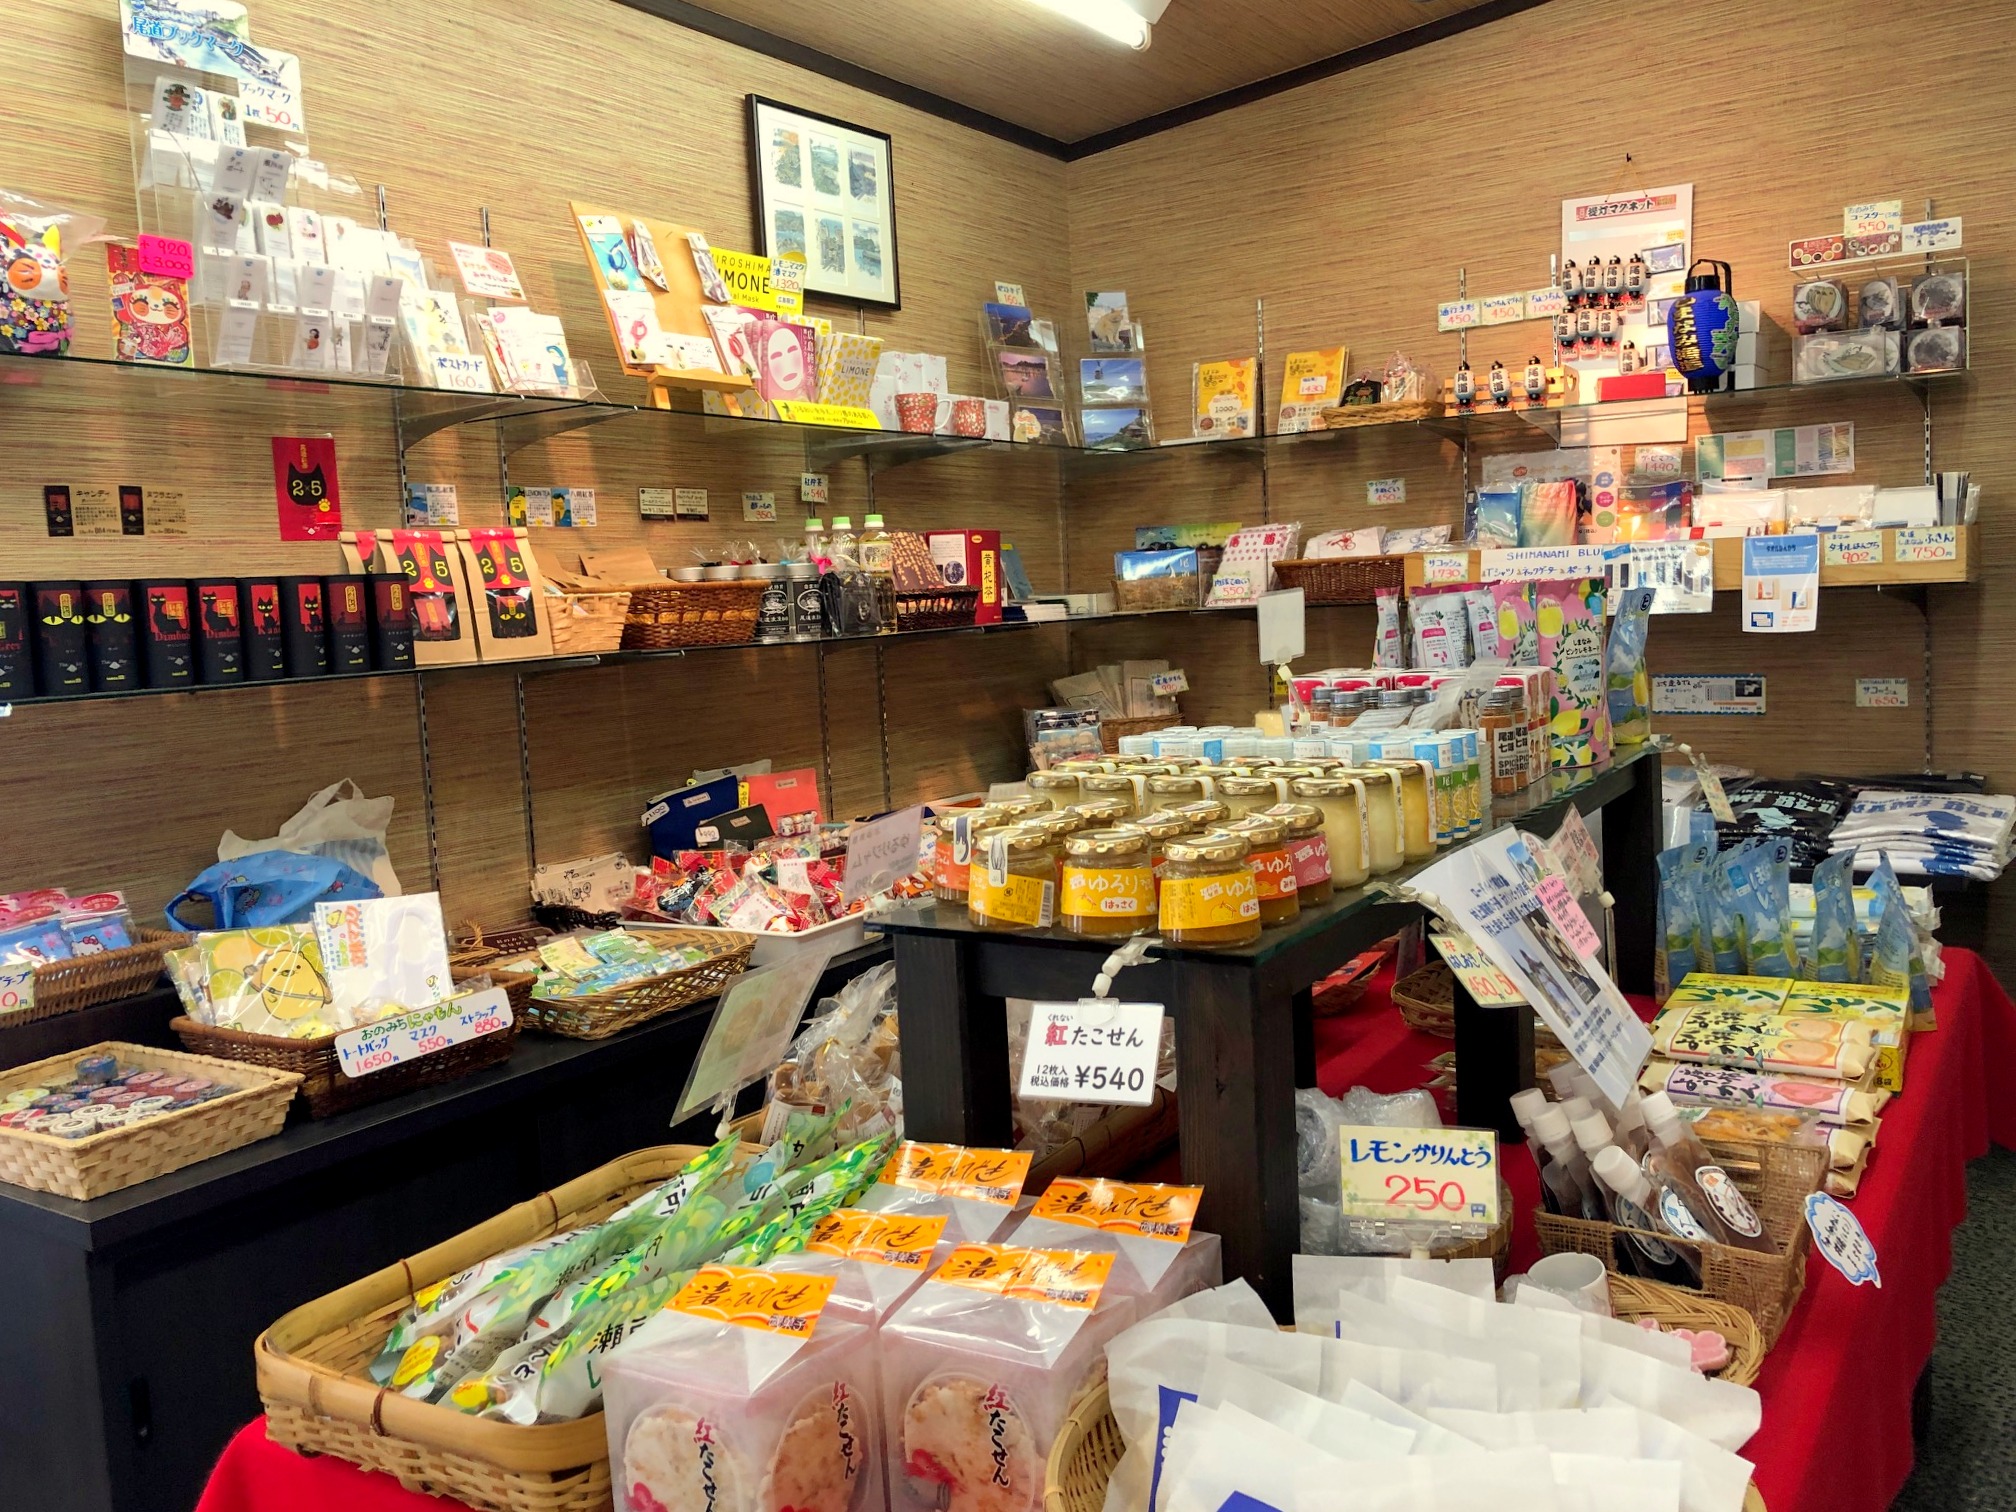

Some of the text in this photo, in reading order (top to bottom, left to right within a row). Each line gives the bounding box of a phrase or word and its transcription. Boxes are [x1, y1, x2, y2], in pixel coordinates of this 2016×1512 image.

[133, 16, 244, 56] 尾道ブックマーク
[241, 83, 291, 103] ブックマーク
[1588, 200, 1655, 217] 提灯マグネット
[1585, 267, 1596, 288] 尾道
[1607, 265, 1618, 287] 尾道
[1629, 265, 1640, 287] 尾道
[1440, 304, 1475, 316] 通行手形
[1558, 315, 1569, 336] 尾道
[1579, 311, 1591, 332] 尾道
[1600, 311, 1611, 332] 尾道
[436, 356, 483, 371] ポストカード
[841, 363, 871, 376] LIMONE
[1622, 351, 1633, 372] 尾道
[1458, 372, 1468, 393] 尾道
[1492, 371, 1504, 393] 尾道
[1528, 368, 1539, 388] 尾道
[1428, 559, 1462, 568] サコッシュ
[1507, 549, 1570, 560] SHIMANAMI
[403, 560, 448, 577] 2 5
[480, 557, 523, 574] 2 5
[983, 553, 994, 599] 黄杞茶
[1573, 638, 1592, 646] しまなみ
[1498, 760, 1516, 768] SPIC
[1498, 768, 1515, 776] BRO
[1774, 796, 1838, 816] BLU
[1949, 802, 2008, 820] BLU
[1105, 900, 1133, 909] はっさく
[1048, 1013, 1073, 1022] くれない
[343, 1005, 498, 1060] トートバッグ マスク ストラップ
[1045, 1022, 1143, 1047] 紅たこせん
[1037, 1064, 1068, 1075] 12枚入
[1075, 1065, 1144, 1091] ¥540
[1030, 1076, 1069, 1088] 税込価格
[1350, 1138, 1491, 1169] レモンかりんとう
[832, 1381, 856, 1480] 紅たこせん
[983, 1383, 1011, 1488] 紅たこせん
